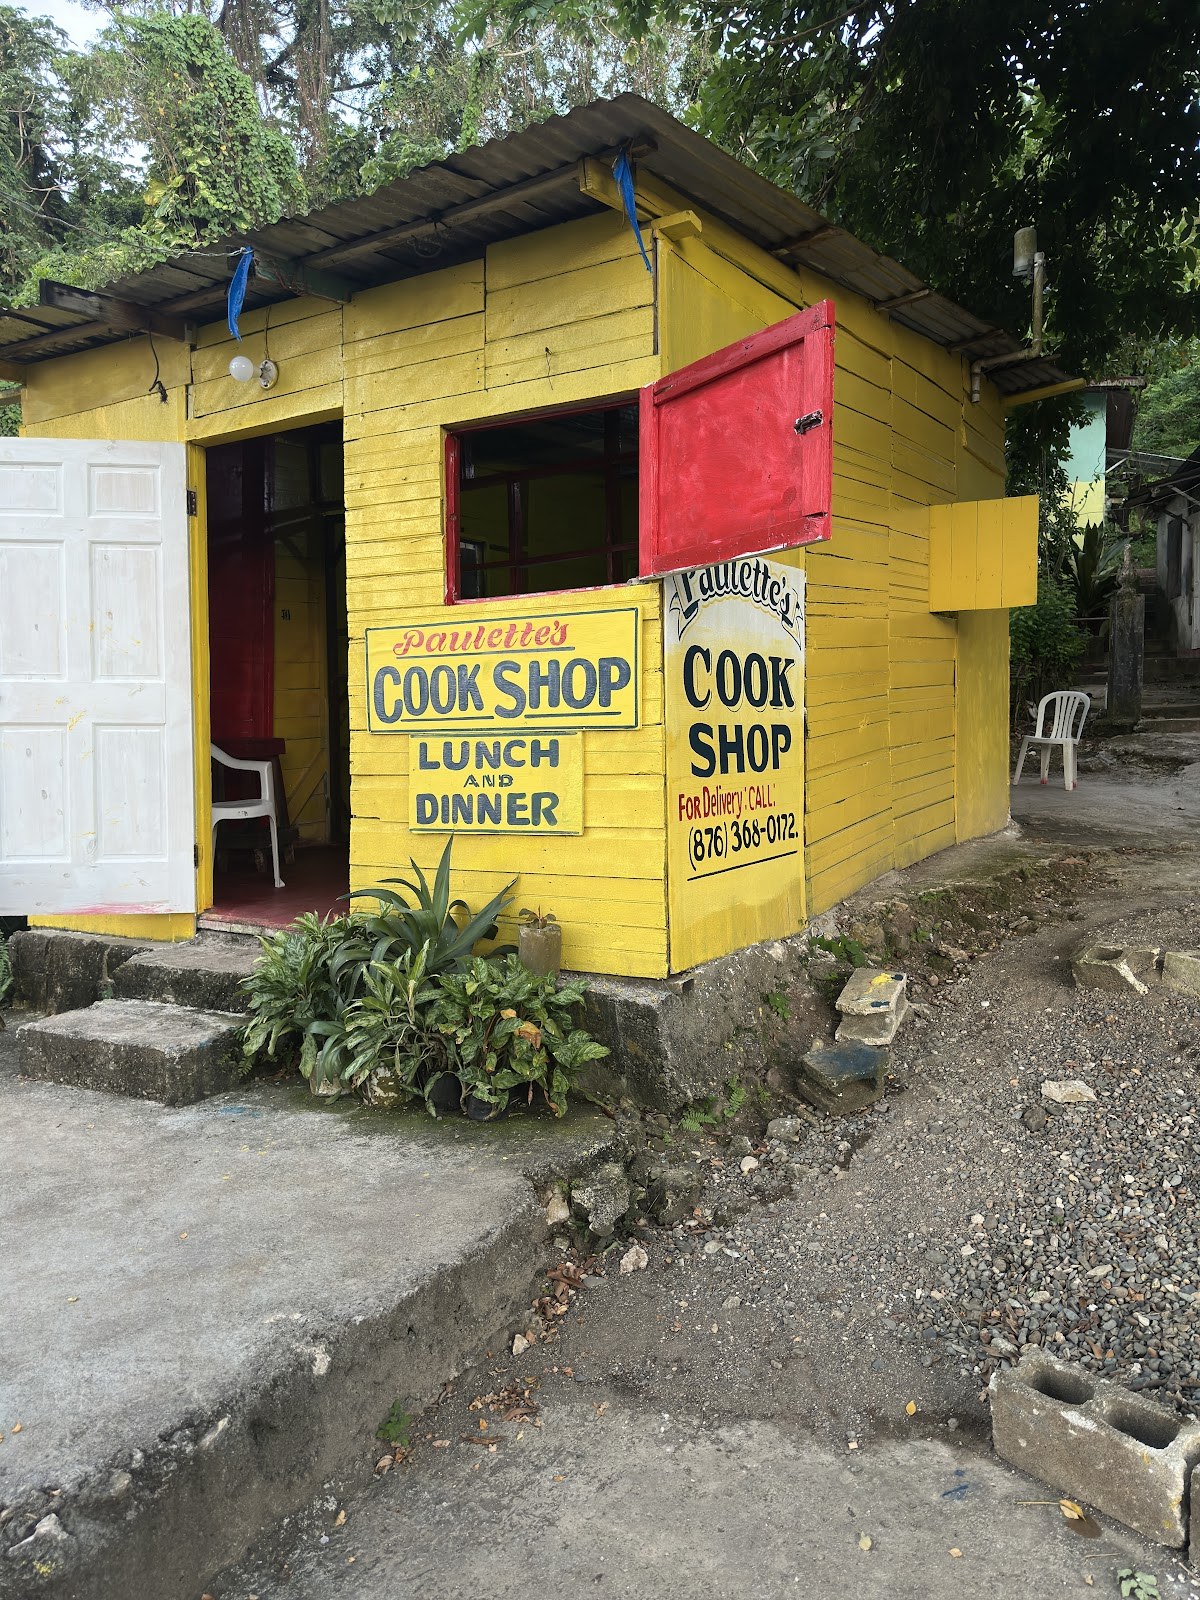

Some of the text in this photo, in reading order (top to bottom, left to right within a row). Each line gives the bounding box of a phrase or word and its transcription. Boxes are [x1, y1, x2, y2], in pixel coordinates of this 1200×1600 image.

[393, 620, 569, 656] Paulette's
[374, 656, 631, 723] COOK SHOP
[683, 644, 796, 712] COOK
[419, 739, 559, 770] LUNCH
[689, 722, 792, 777] SHOP
[463, 774, 514, 788] AND
[416, 792, 560, 826] DINNER
[688, 822, 728, 871] (876)
